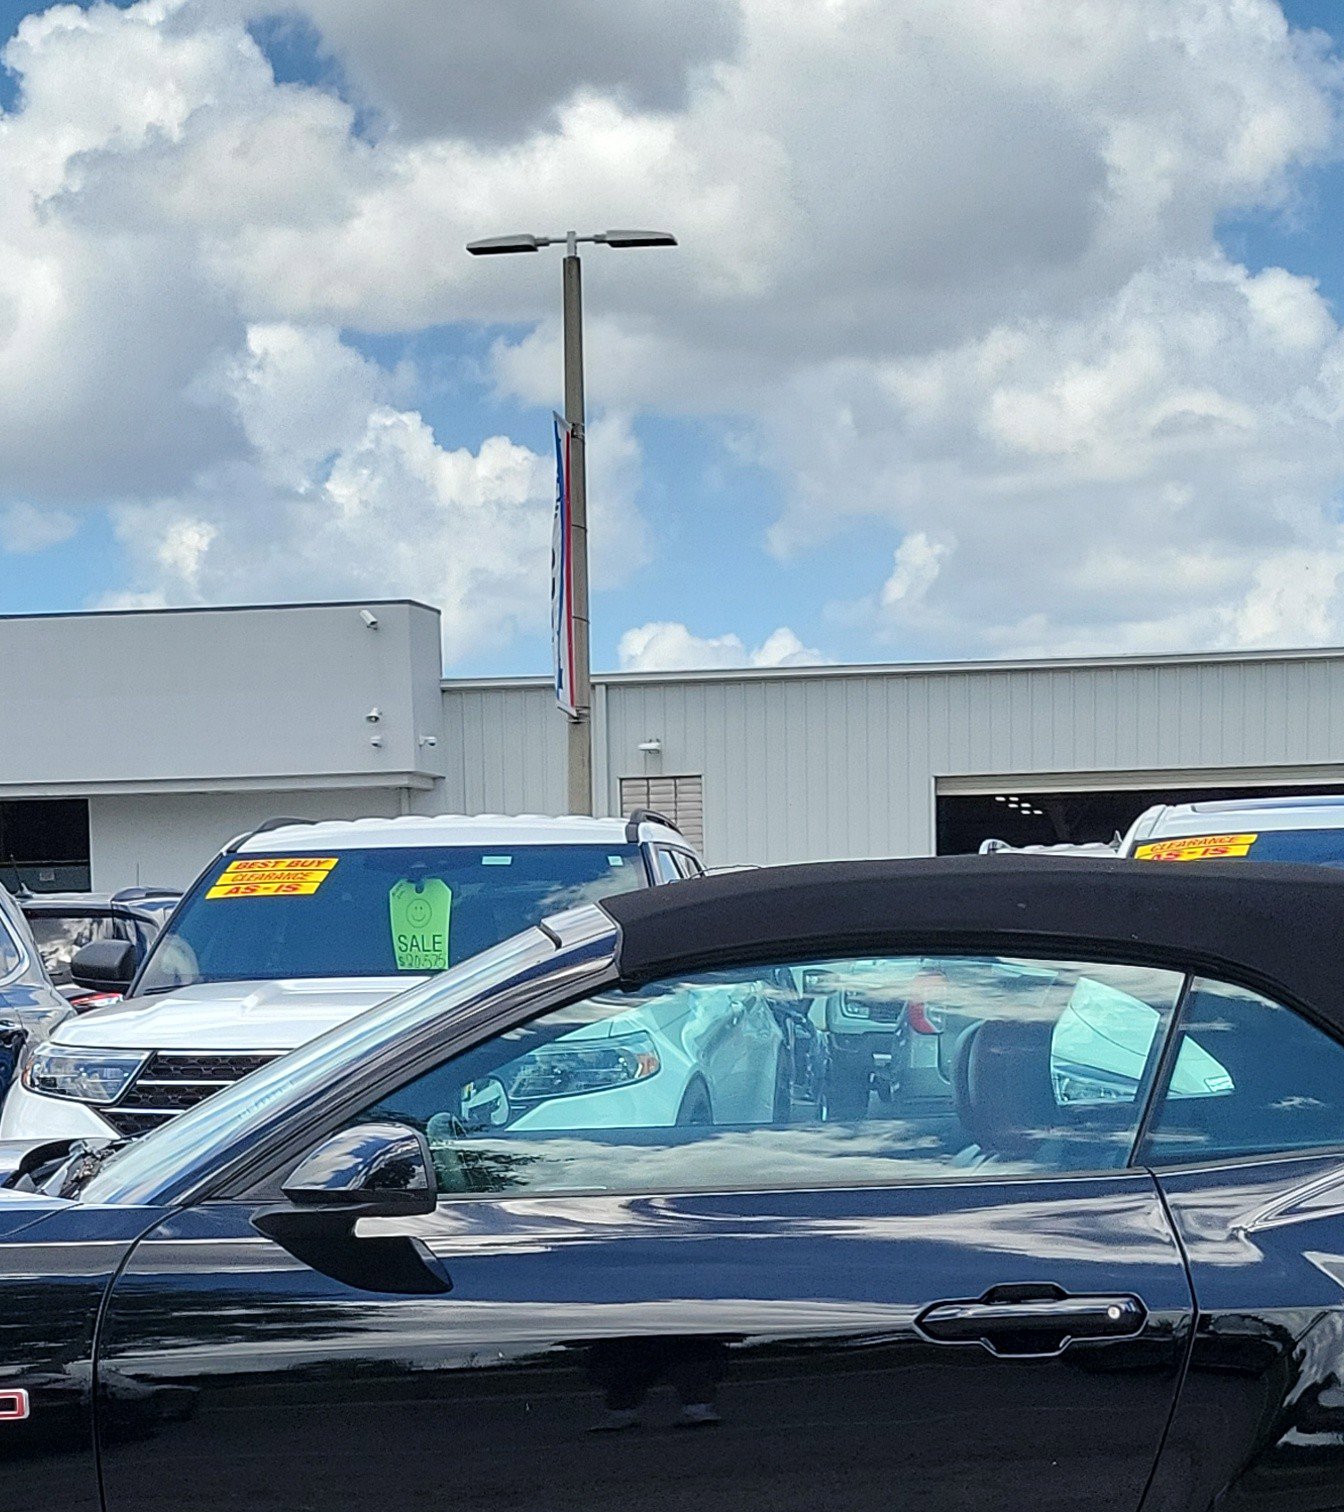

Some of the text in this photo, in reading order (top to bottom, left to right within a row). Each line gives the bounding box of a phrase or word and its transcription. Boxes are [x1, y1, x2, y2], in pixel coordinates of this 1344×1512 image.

[1150, 836, 1238, 852] CLEARANCE
[235, 860, 329, 870] BEST BUY
[231, 872, 313, 882] CLEARANCE
[224, 883, 302, 895] AS-IS
[398, 934, 442, 952] SALE
